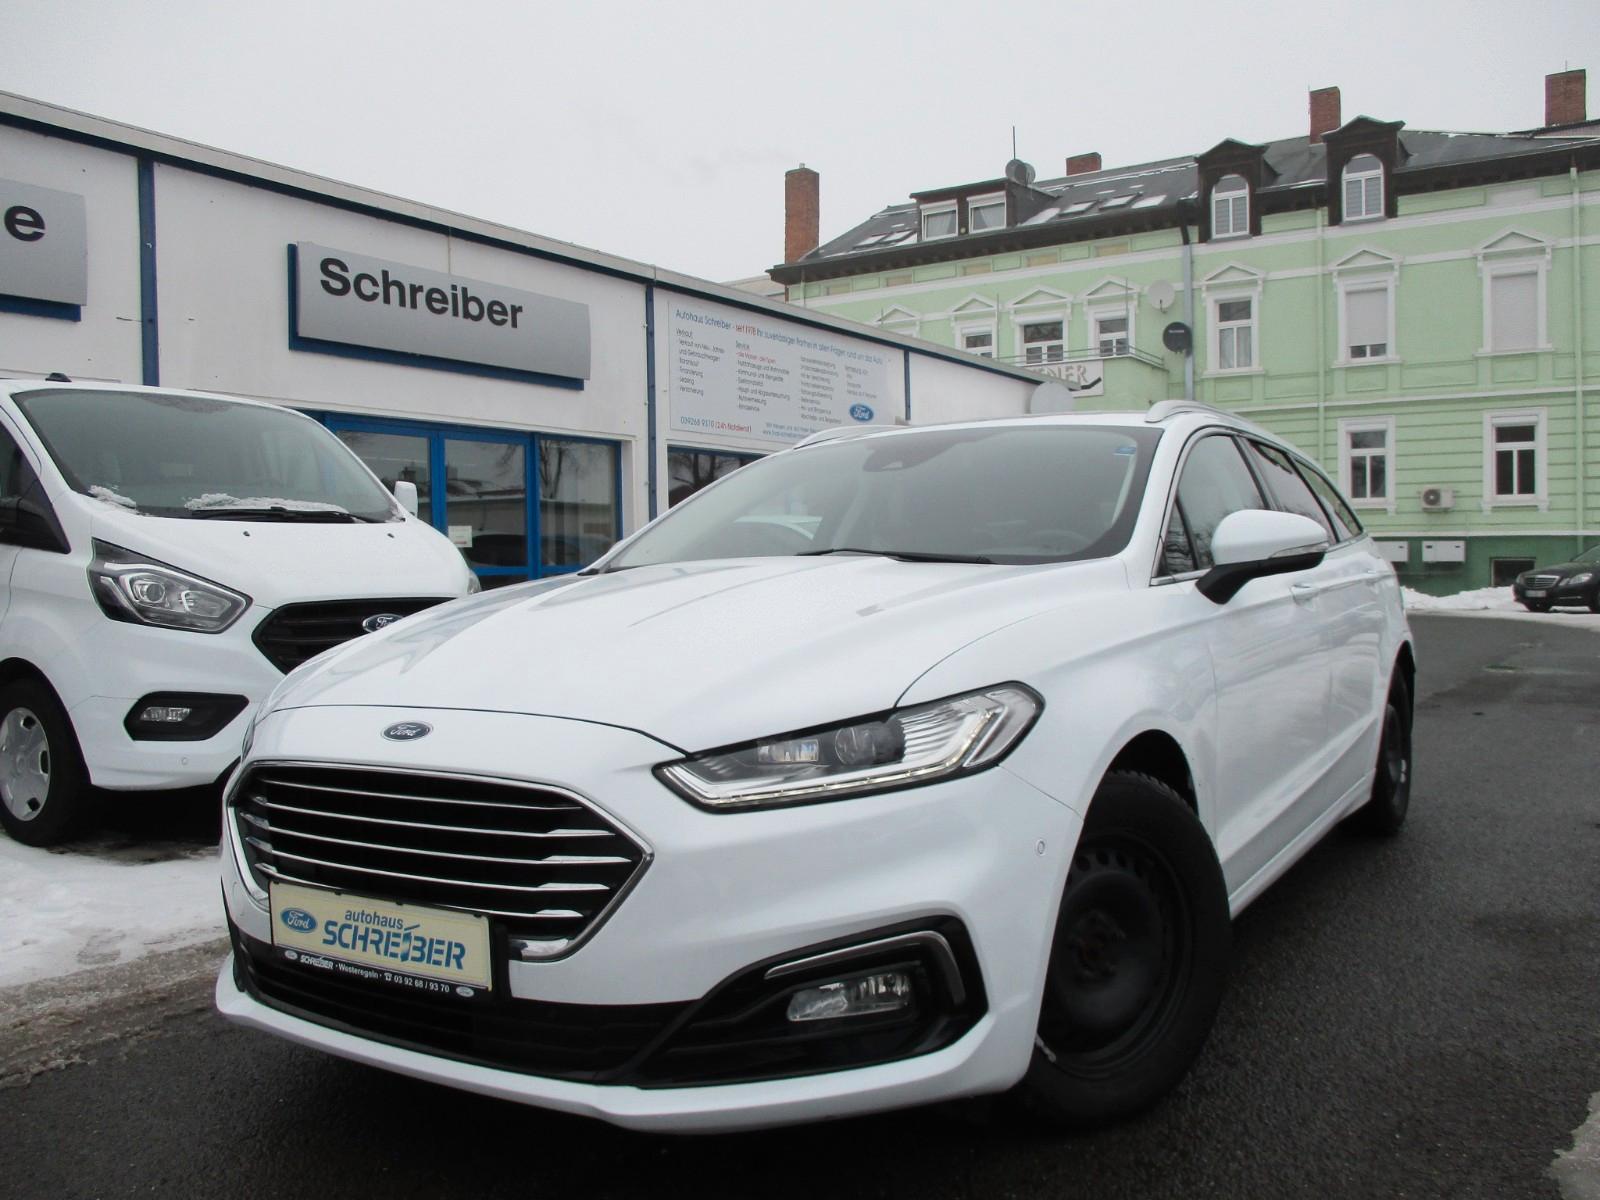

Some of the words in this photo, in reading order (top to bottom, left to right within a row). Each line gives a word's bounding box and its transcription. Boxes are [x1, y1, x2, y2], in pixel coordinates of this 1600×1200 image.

[319, 257, 524, 329] Schreiber
[676, 309, 704, 325] Autohaus
[704, 315, 732, 330] Schreiber
[852, 406, 871, 420] Ford
[284, 910, 313, 931] Ford
[344, 909, 404, 931] autohaus
[321, 920, 466, 970] SCHREIBER
[300, 954, 334, 970] SCHREIBER
[393, 975, 403, 984] 03
[404, 977, 413, 986] 92
[429, 982, 439, 991] 93
[440, 984, 450, 993] 70
